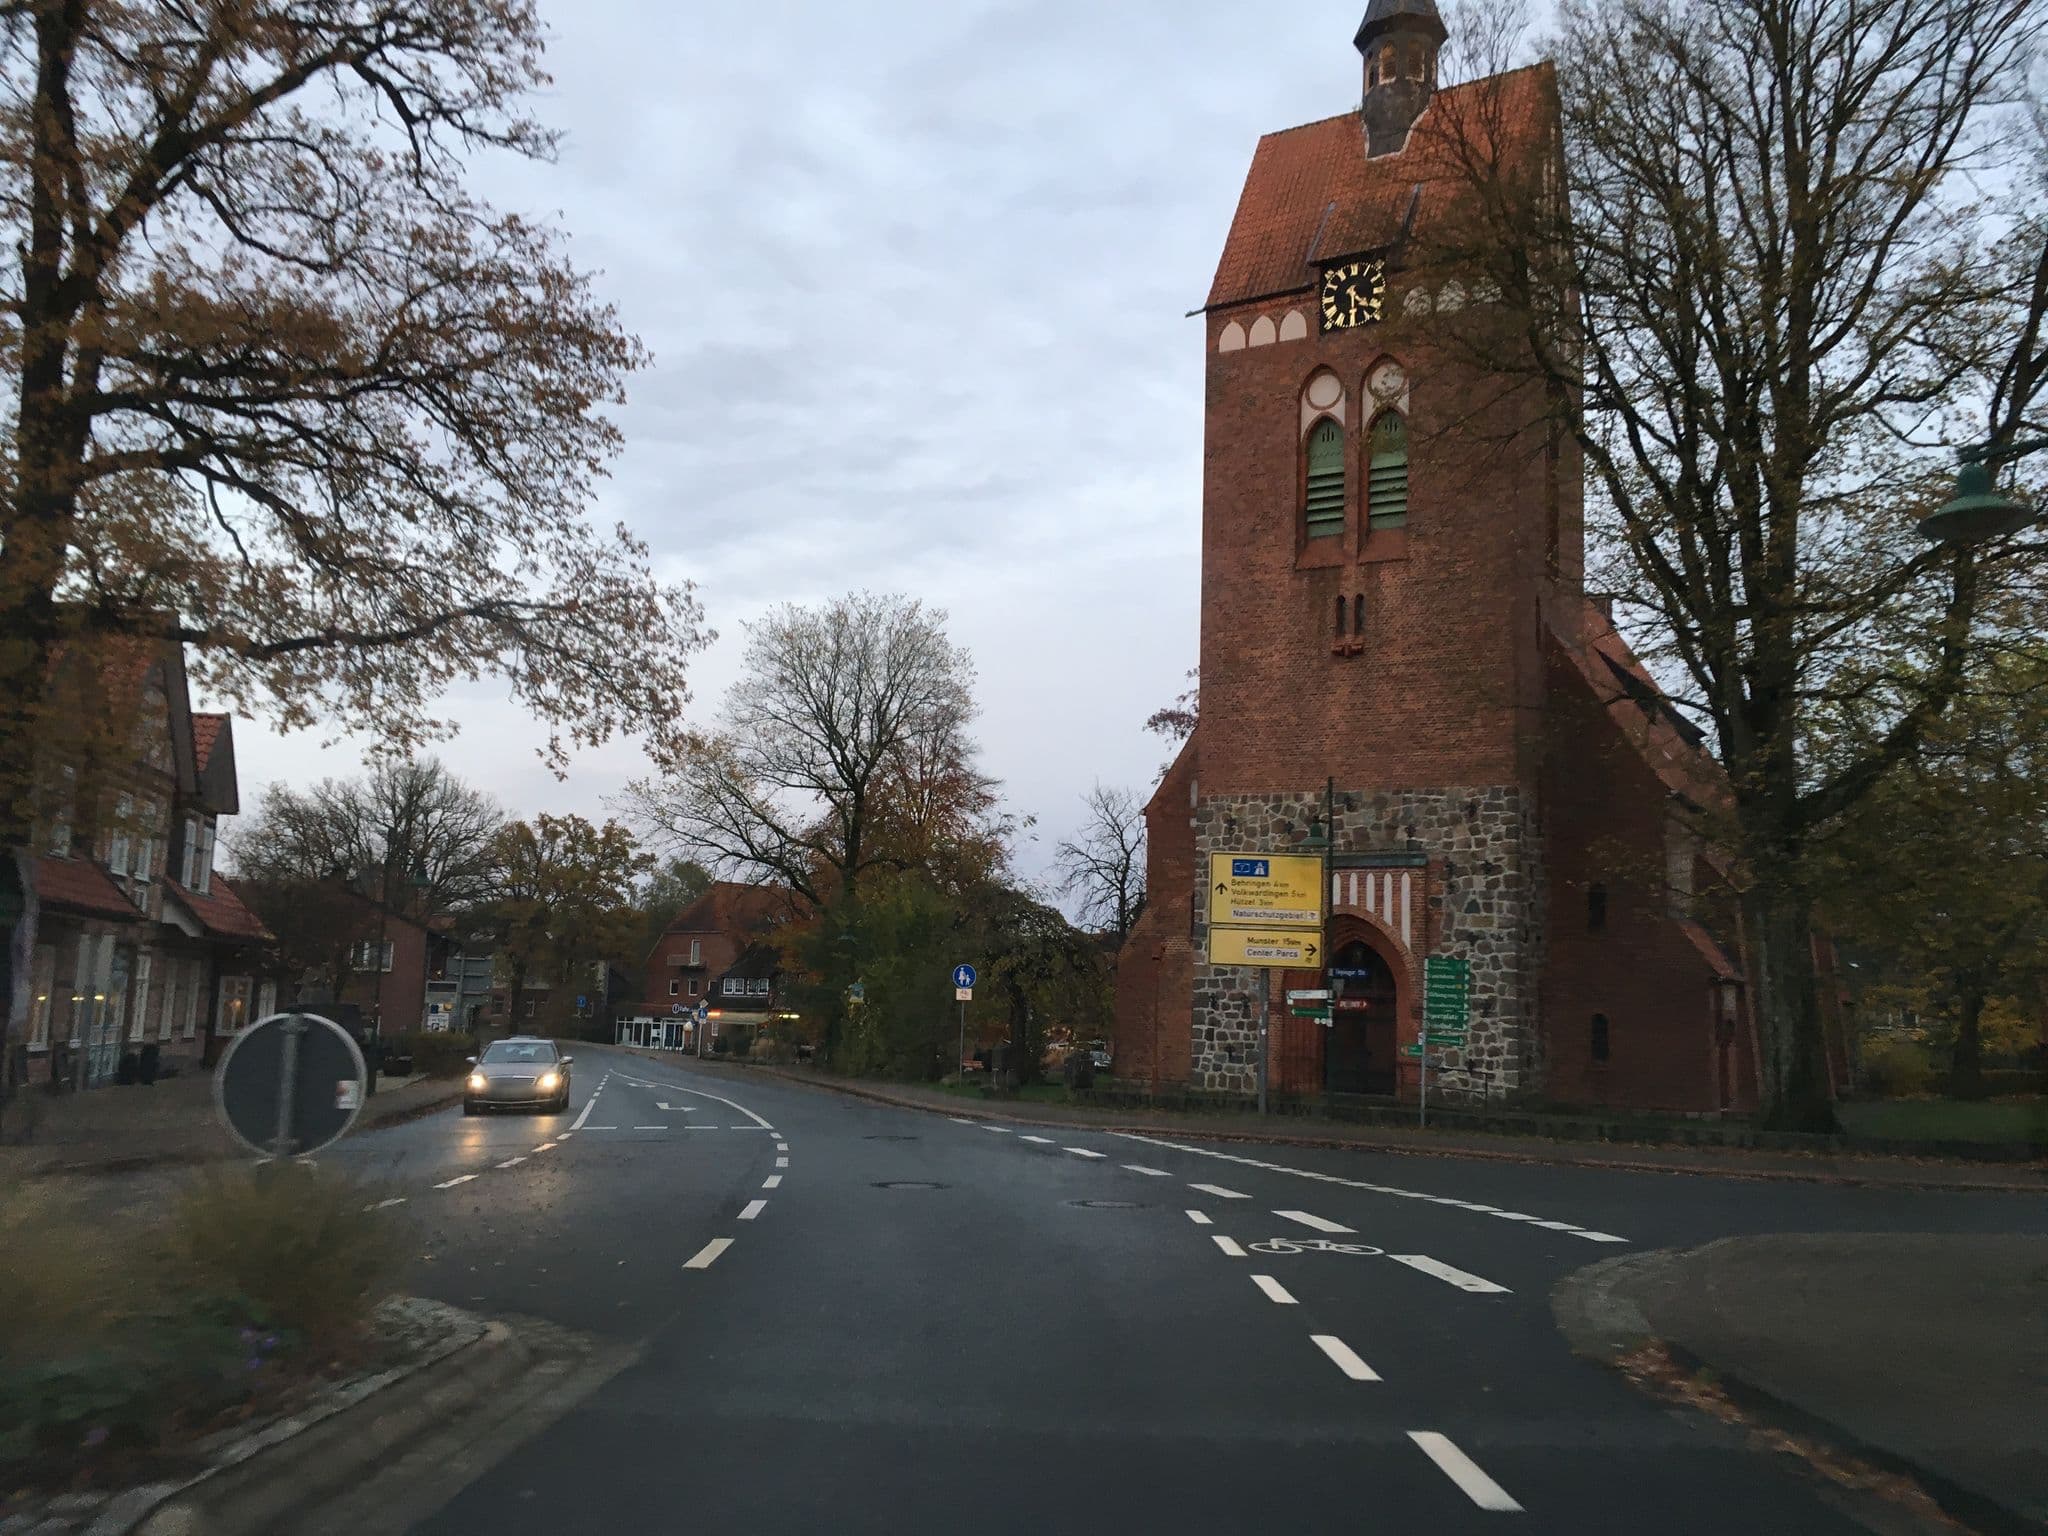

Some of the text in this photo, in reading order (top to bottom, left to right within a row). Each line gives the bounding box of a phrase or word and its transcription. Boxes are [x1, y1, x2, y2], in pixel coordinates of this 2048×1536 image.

[1231, 879, 1271, 888] Behringen
[1231, 889, 1288, 898] Volkwardingen
[1232, 910, 1304, 919] Naturschutzgebiet
[1247, 948, 1298, 958] Center Parcs
